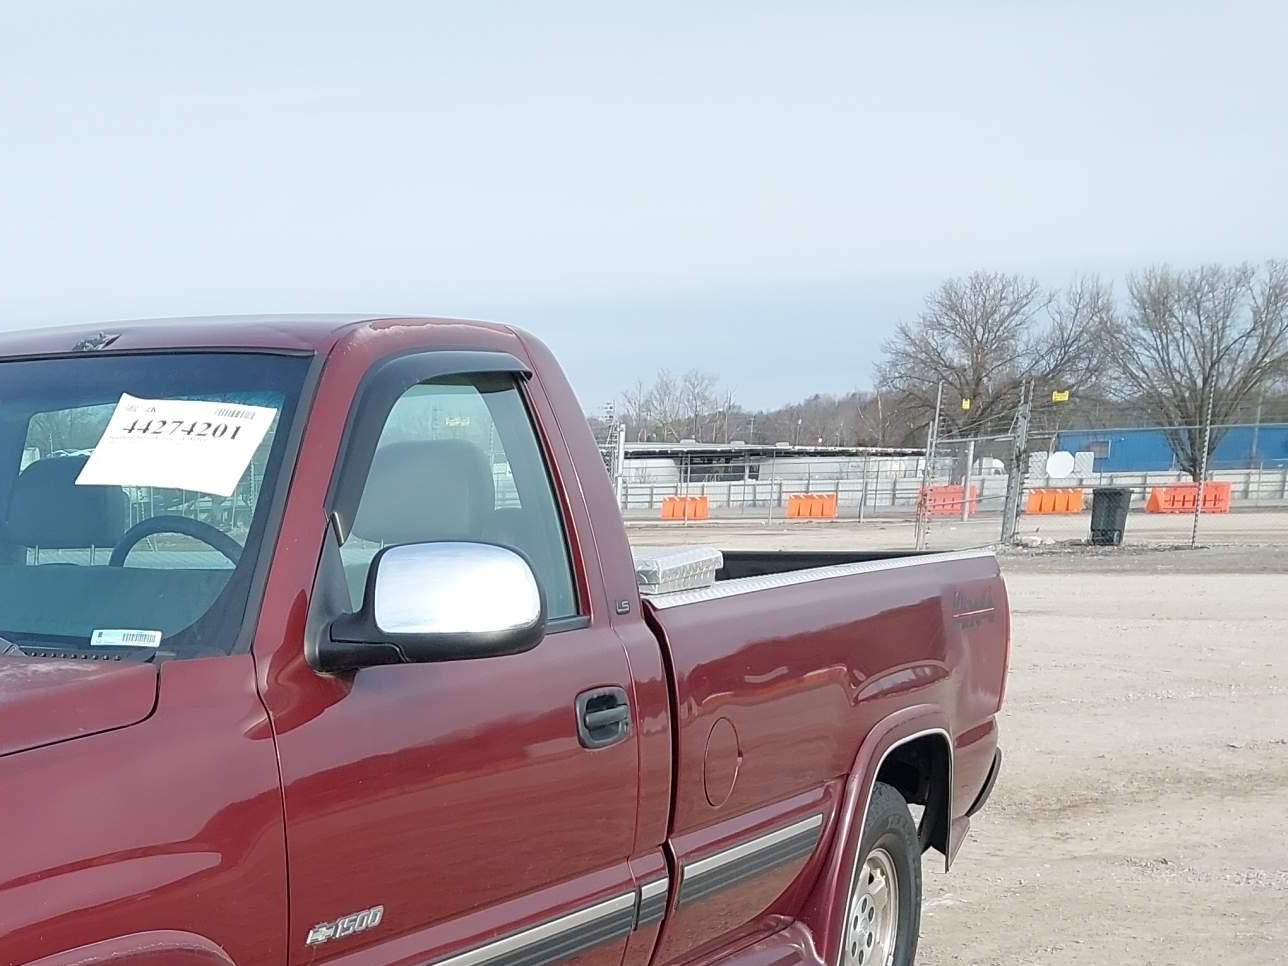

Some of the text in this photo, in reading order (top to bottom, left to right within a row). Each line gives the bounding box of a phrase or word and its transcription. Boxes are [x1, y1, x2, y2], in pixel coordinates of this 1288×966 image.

[122, 418, 242, 441] 44274201
[616, 600, 631, 615] LS
[335, 904, 384, 939] 1500
